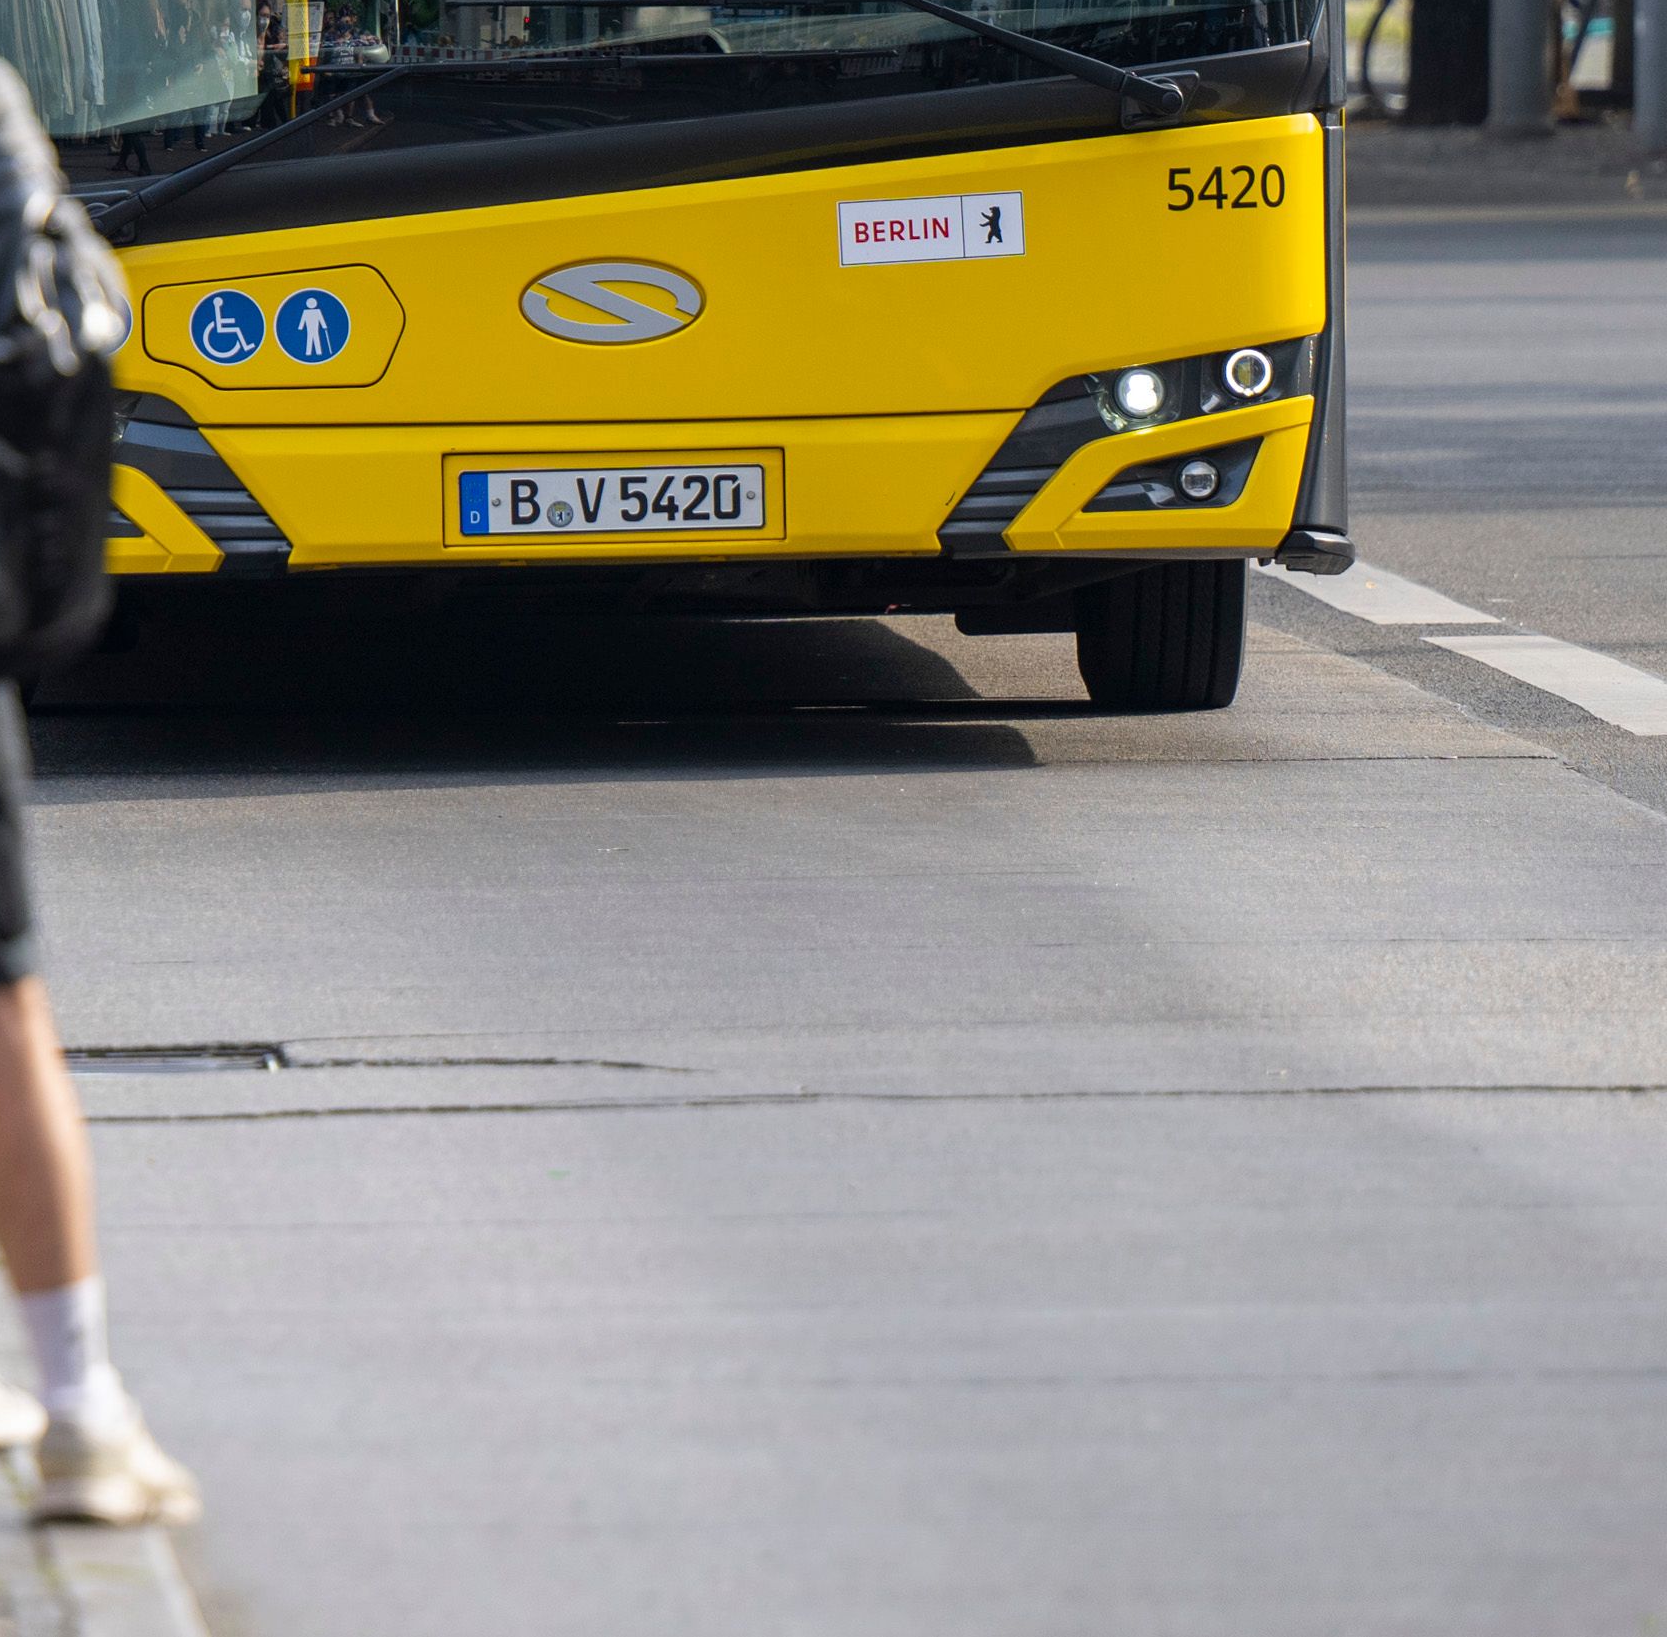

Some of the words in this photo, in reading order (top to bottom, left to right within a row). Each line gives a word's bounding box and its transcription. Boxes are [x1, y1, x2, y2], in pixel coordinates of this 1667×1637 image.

[1167, 163, 1286, 212] 5420
[854, 216, 950, 244] BERLIN
[469, 510, 481, 525] D
[509, 478, 541, 525] B
[575, 475, 606, 523] V
[619, 473, 741, 522] 5420
